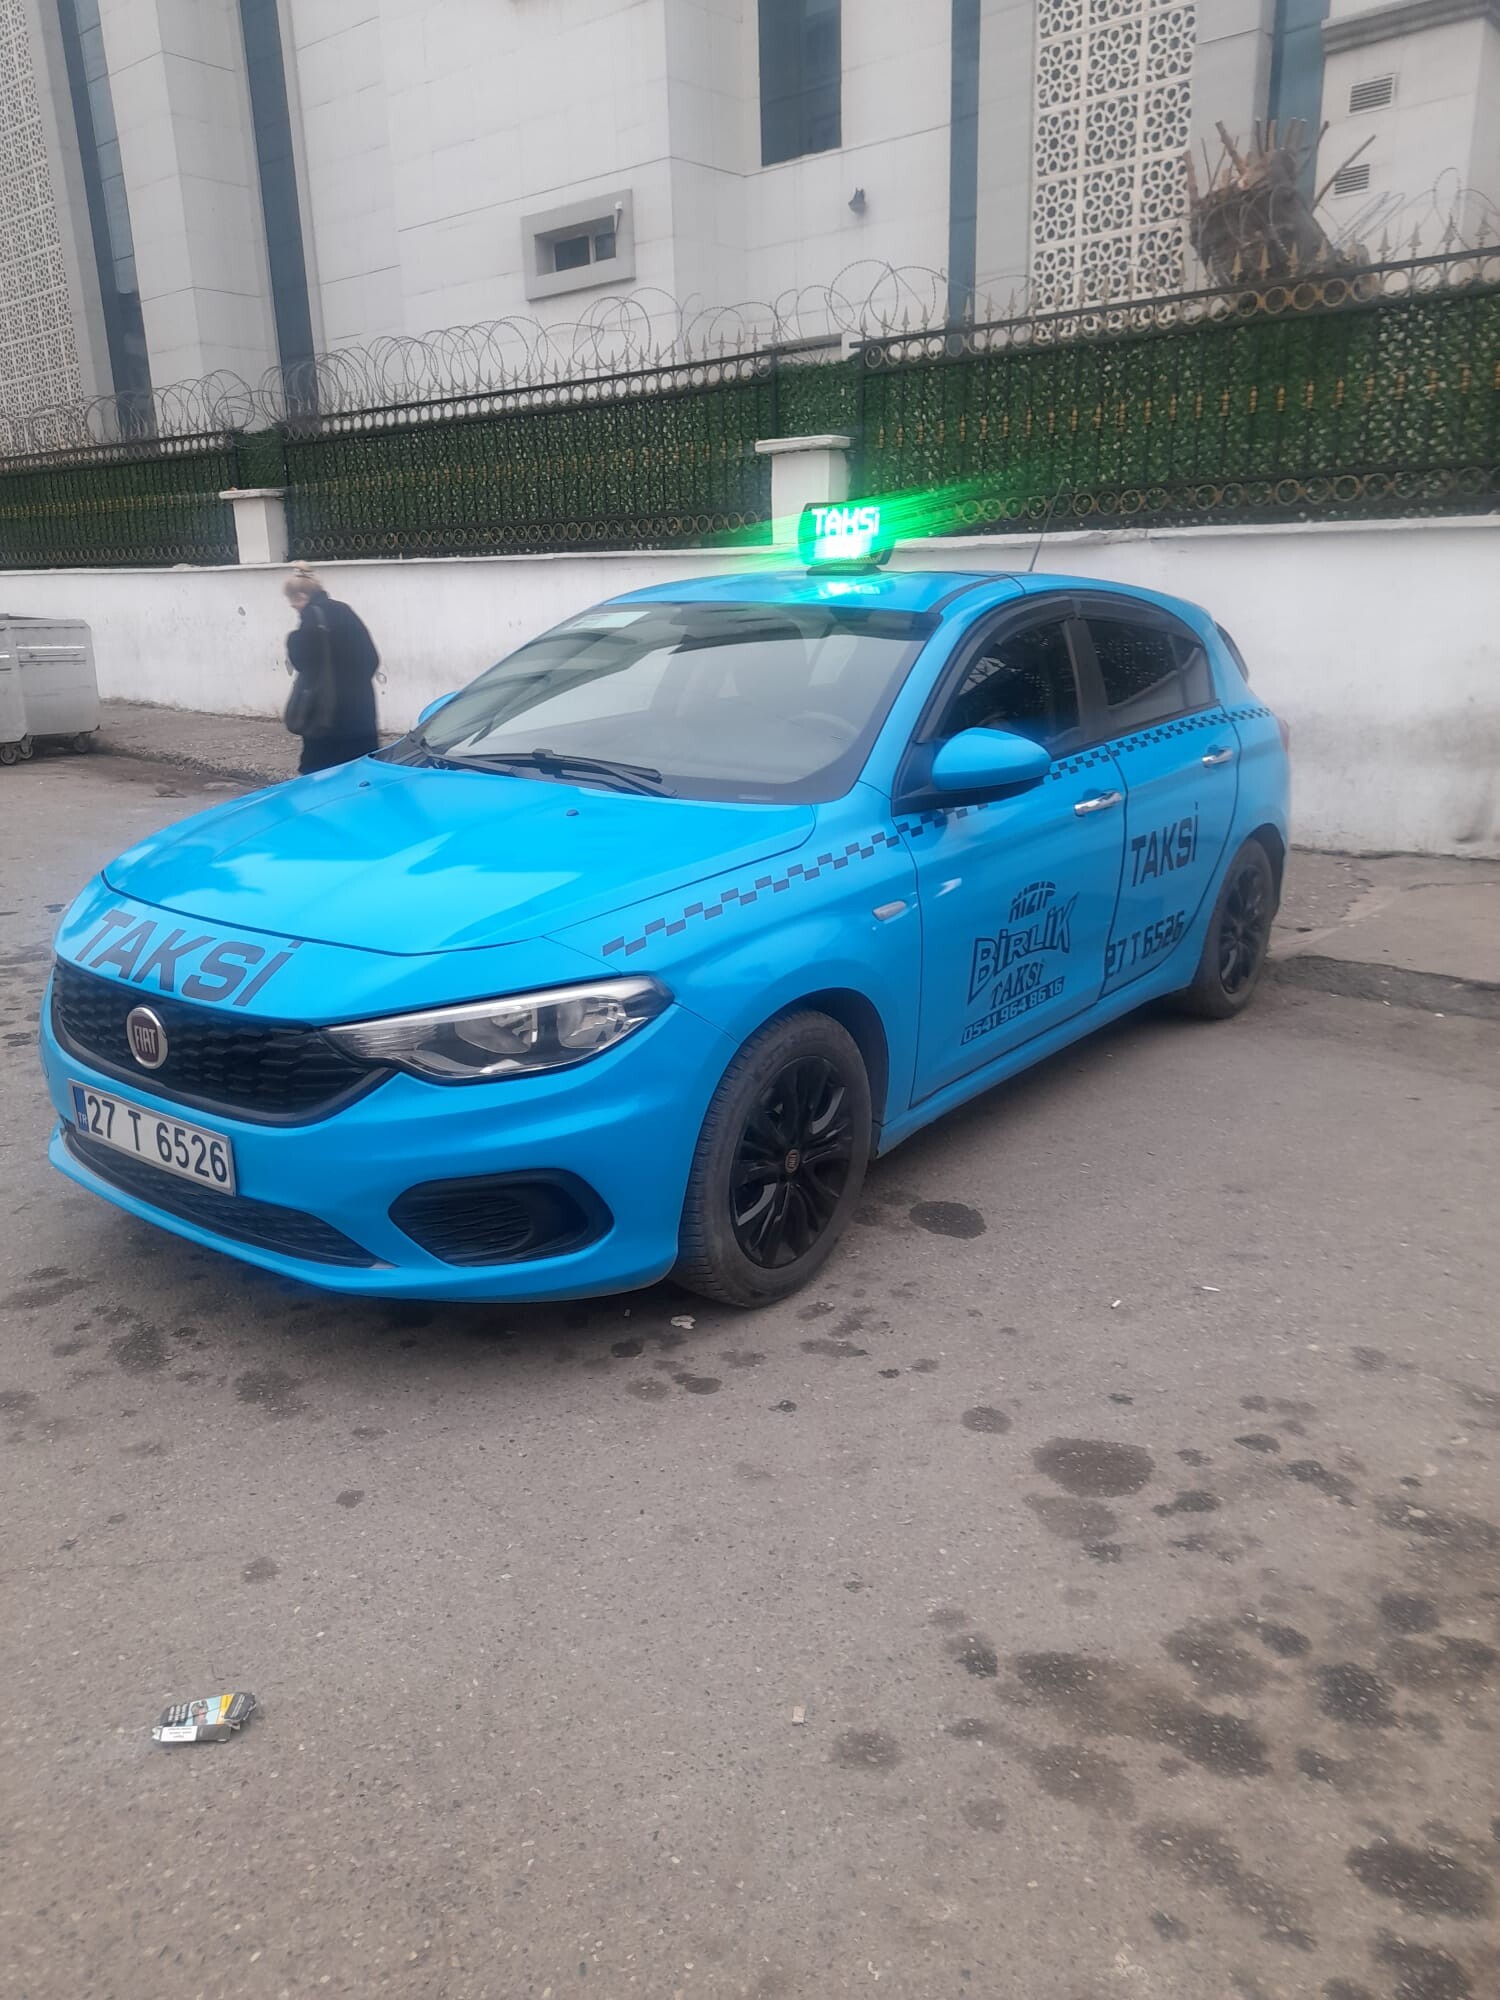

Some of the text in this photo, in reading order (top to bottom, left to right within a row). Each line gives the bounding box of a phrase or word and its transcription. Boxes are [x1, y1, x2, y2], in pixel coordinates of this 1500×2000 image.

[1131, 801, 1199, 888] TAKSİ
[75, 908, 304, 1007] TAKSİ
[967, 890, 1081, 1005] BİRLİK
[1131, 930, 1141, 966] T
[1141, 910, 1185, 960] 6526
[133, 1024, 156, 1055] FIAT
[962, 978, 1064, 1044] 0541 964 86 16
[77, 1095, 228, 1183] TR 27 T 6526
